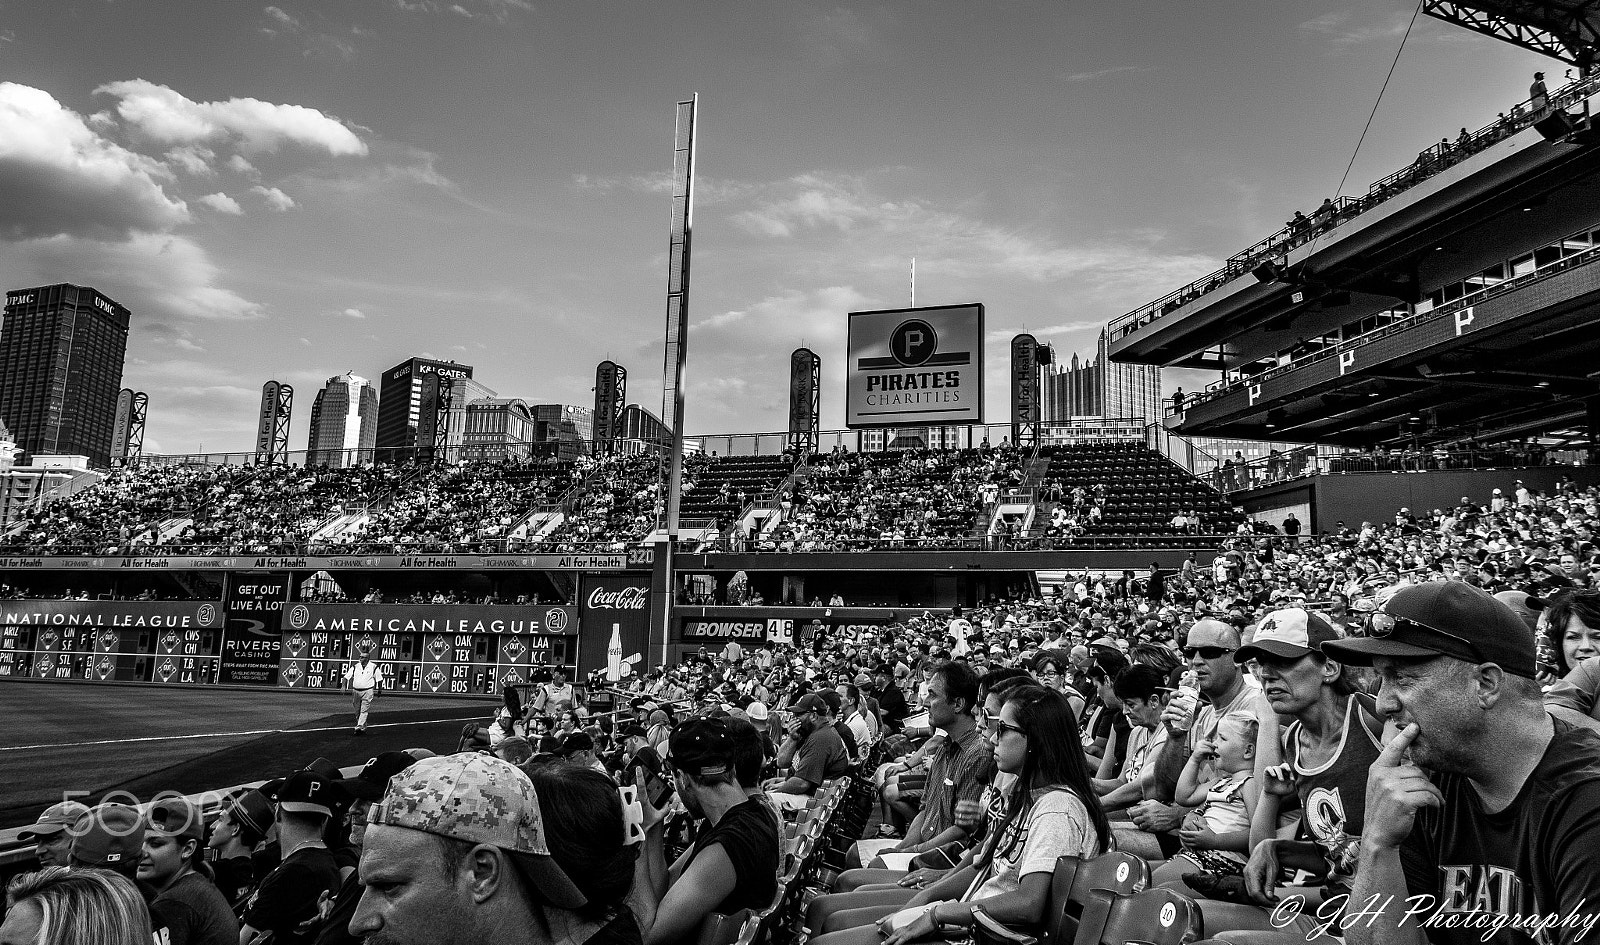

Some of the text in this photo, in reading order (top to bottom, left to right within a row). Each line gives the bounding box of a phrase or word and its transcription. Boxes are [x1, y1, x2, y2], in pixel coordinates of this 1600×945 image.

[6, 294, 34, 306] UPMC
[95, 296, 115, 316] UPMC
[905, 330, 924, 357] P
[438, 368, 467, 379] GATES
[600, 368, 611, 403] Health
[866, 370, 960, 391] PIRATES
[1018, 342, 1029, 420] All for Health
[866, 390, 961, 406] CHARITIES
[260, 387, 275, 450] All for Health
[599, 423, 608, 438] All
[558, 557, 621, 567] All for Health
[628, 549, 655, 564] 320
[9, 559, 19, 568] for
[20, 559, 43, 568] Health
[121, 559, 169, 568] All for Health
[254, 558, 306, 568] All for Health
[400, 558, 457, 568] All for Health
[238, 585, 281, 595] GET OUT
[588, 586, 650, 609] Coca-Cola
[230, 601, 285, 611] LIVE A LOT
[6, 613, 191, 628] NATIONAL LEAGUE
[314, 618, 539, 634] AMERICAN LEAGUE
[4, 626, 19, 636] ARIZ
[64, 627, 76, 638] CIN
[695, 620, 794, 638] BOWSER 48
[185, 630, 200, 641] CWS
[312, 632, 328, 643] WSH
[383, 634, 397, 645] ATL
[455, 635, 472, 647] OAK
[3, 638, 15, 649] MIL
[62, 640, 72, 651] S.F.
[226, 640, 281, 651] RIVERS
[333, 639, 341, 651] F
[533, 636, 549, 648] LAA
[184, 643, 197, 654] CHI
[312, 646, 325, 658] CLE
[381, 648, 397, 660] MIN
[0, 652, 14, 663] PHIL
[60, 654, 71, 665] STL
[234, 651, 271, 659] CASINO
[455, 649, 470, 661] TEX
[531, 651, 547, 664] K.C.
[183, 658, 195, 669] T.B.
[310, 661, 324, 673] S.D.
[56, 667, 71, 678] NYM
[181, 671, 194, 683] L.A.
[331, 669, 337, 681] F
[453, 665, 469, 678] DET
[489, 667, 496, 680] 4
[308, 675, 322, 687] TOR
[477, 673, 484, 686] F
[451, 680, 468, 693] BOS
[308, 781, 321, 797] P
[1119, 866, 1126, 878] 9
[1162, 907, 1173, 922] 10
